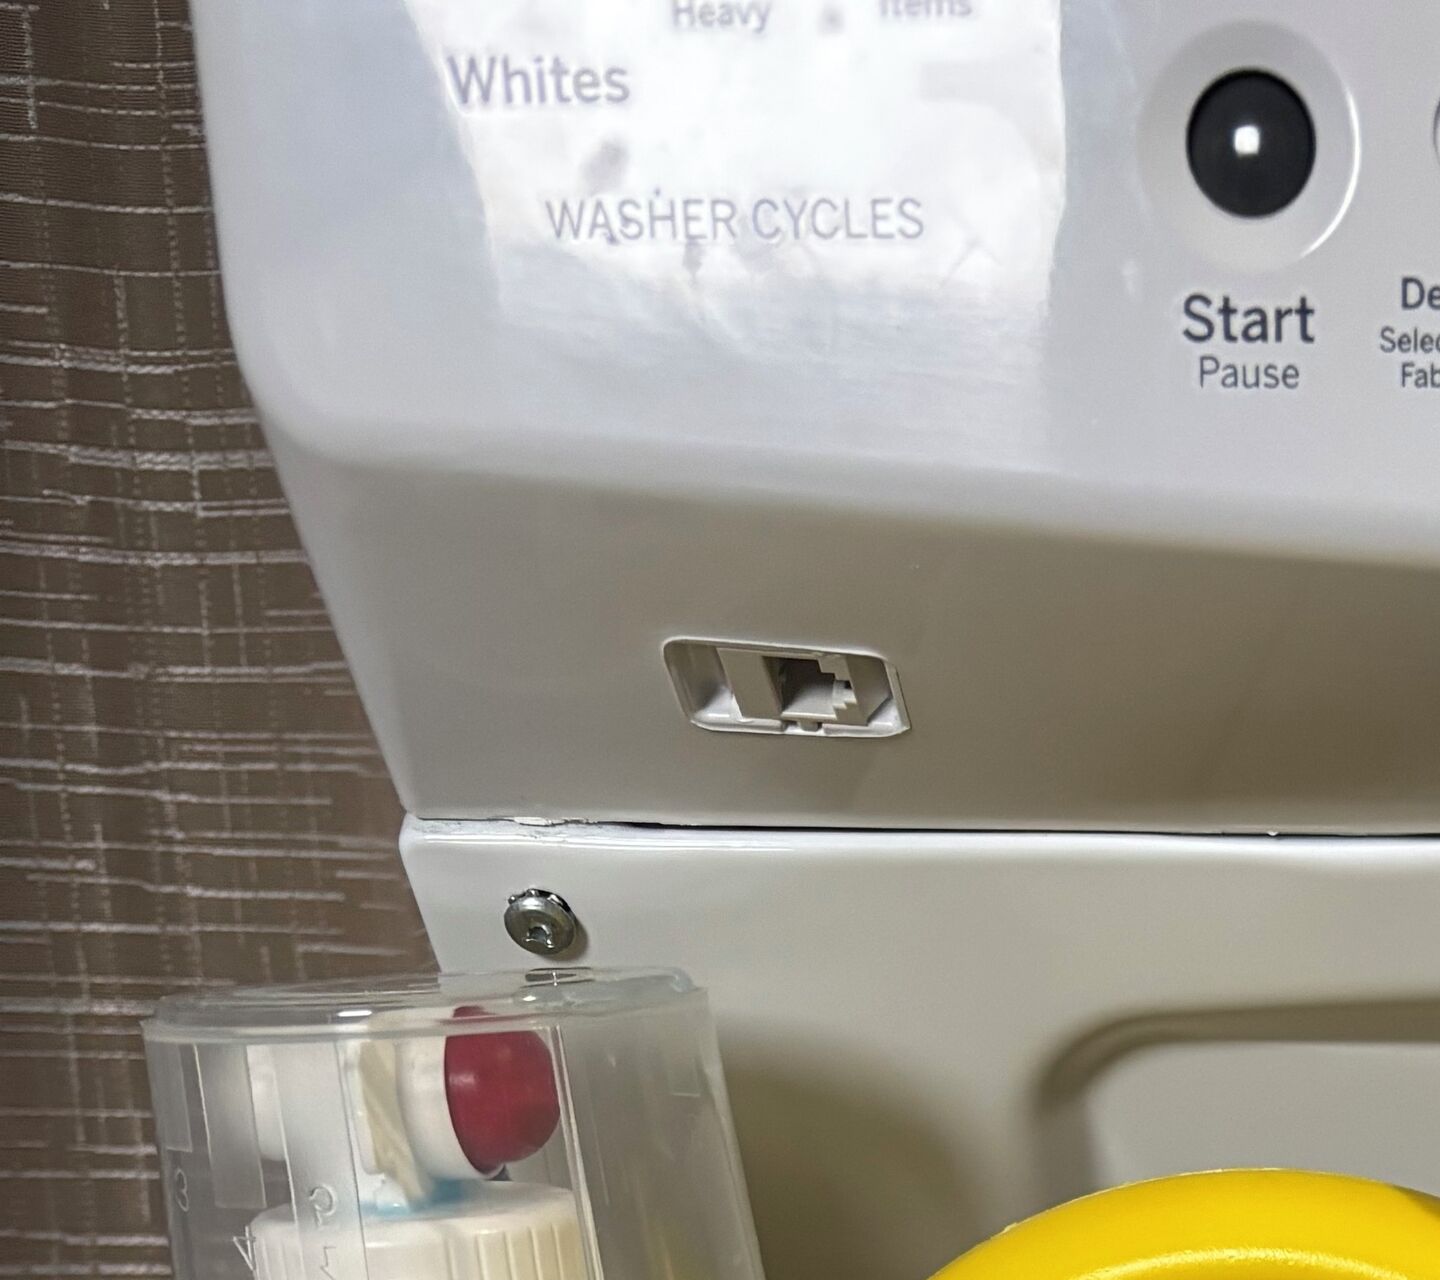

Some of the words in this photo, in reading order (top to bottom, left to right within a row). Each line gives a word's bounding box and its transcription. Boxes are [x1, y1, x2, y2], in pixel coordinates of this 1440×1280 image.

[673, 0, 771, 33] Heavy
[446, 54, 632, 108] Whites
[545, 198, 738, 242] WASHER
[751, 198, 925, 242] CYCLES
[1181, 293, 1316, 344] Start
[1199, 355, 1301, 390] Pause
